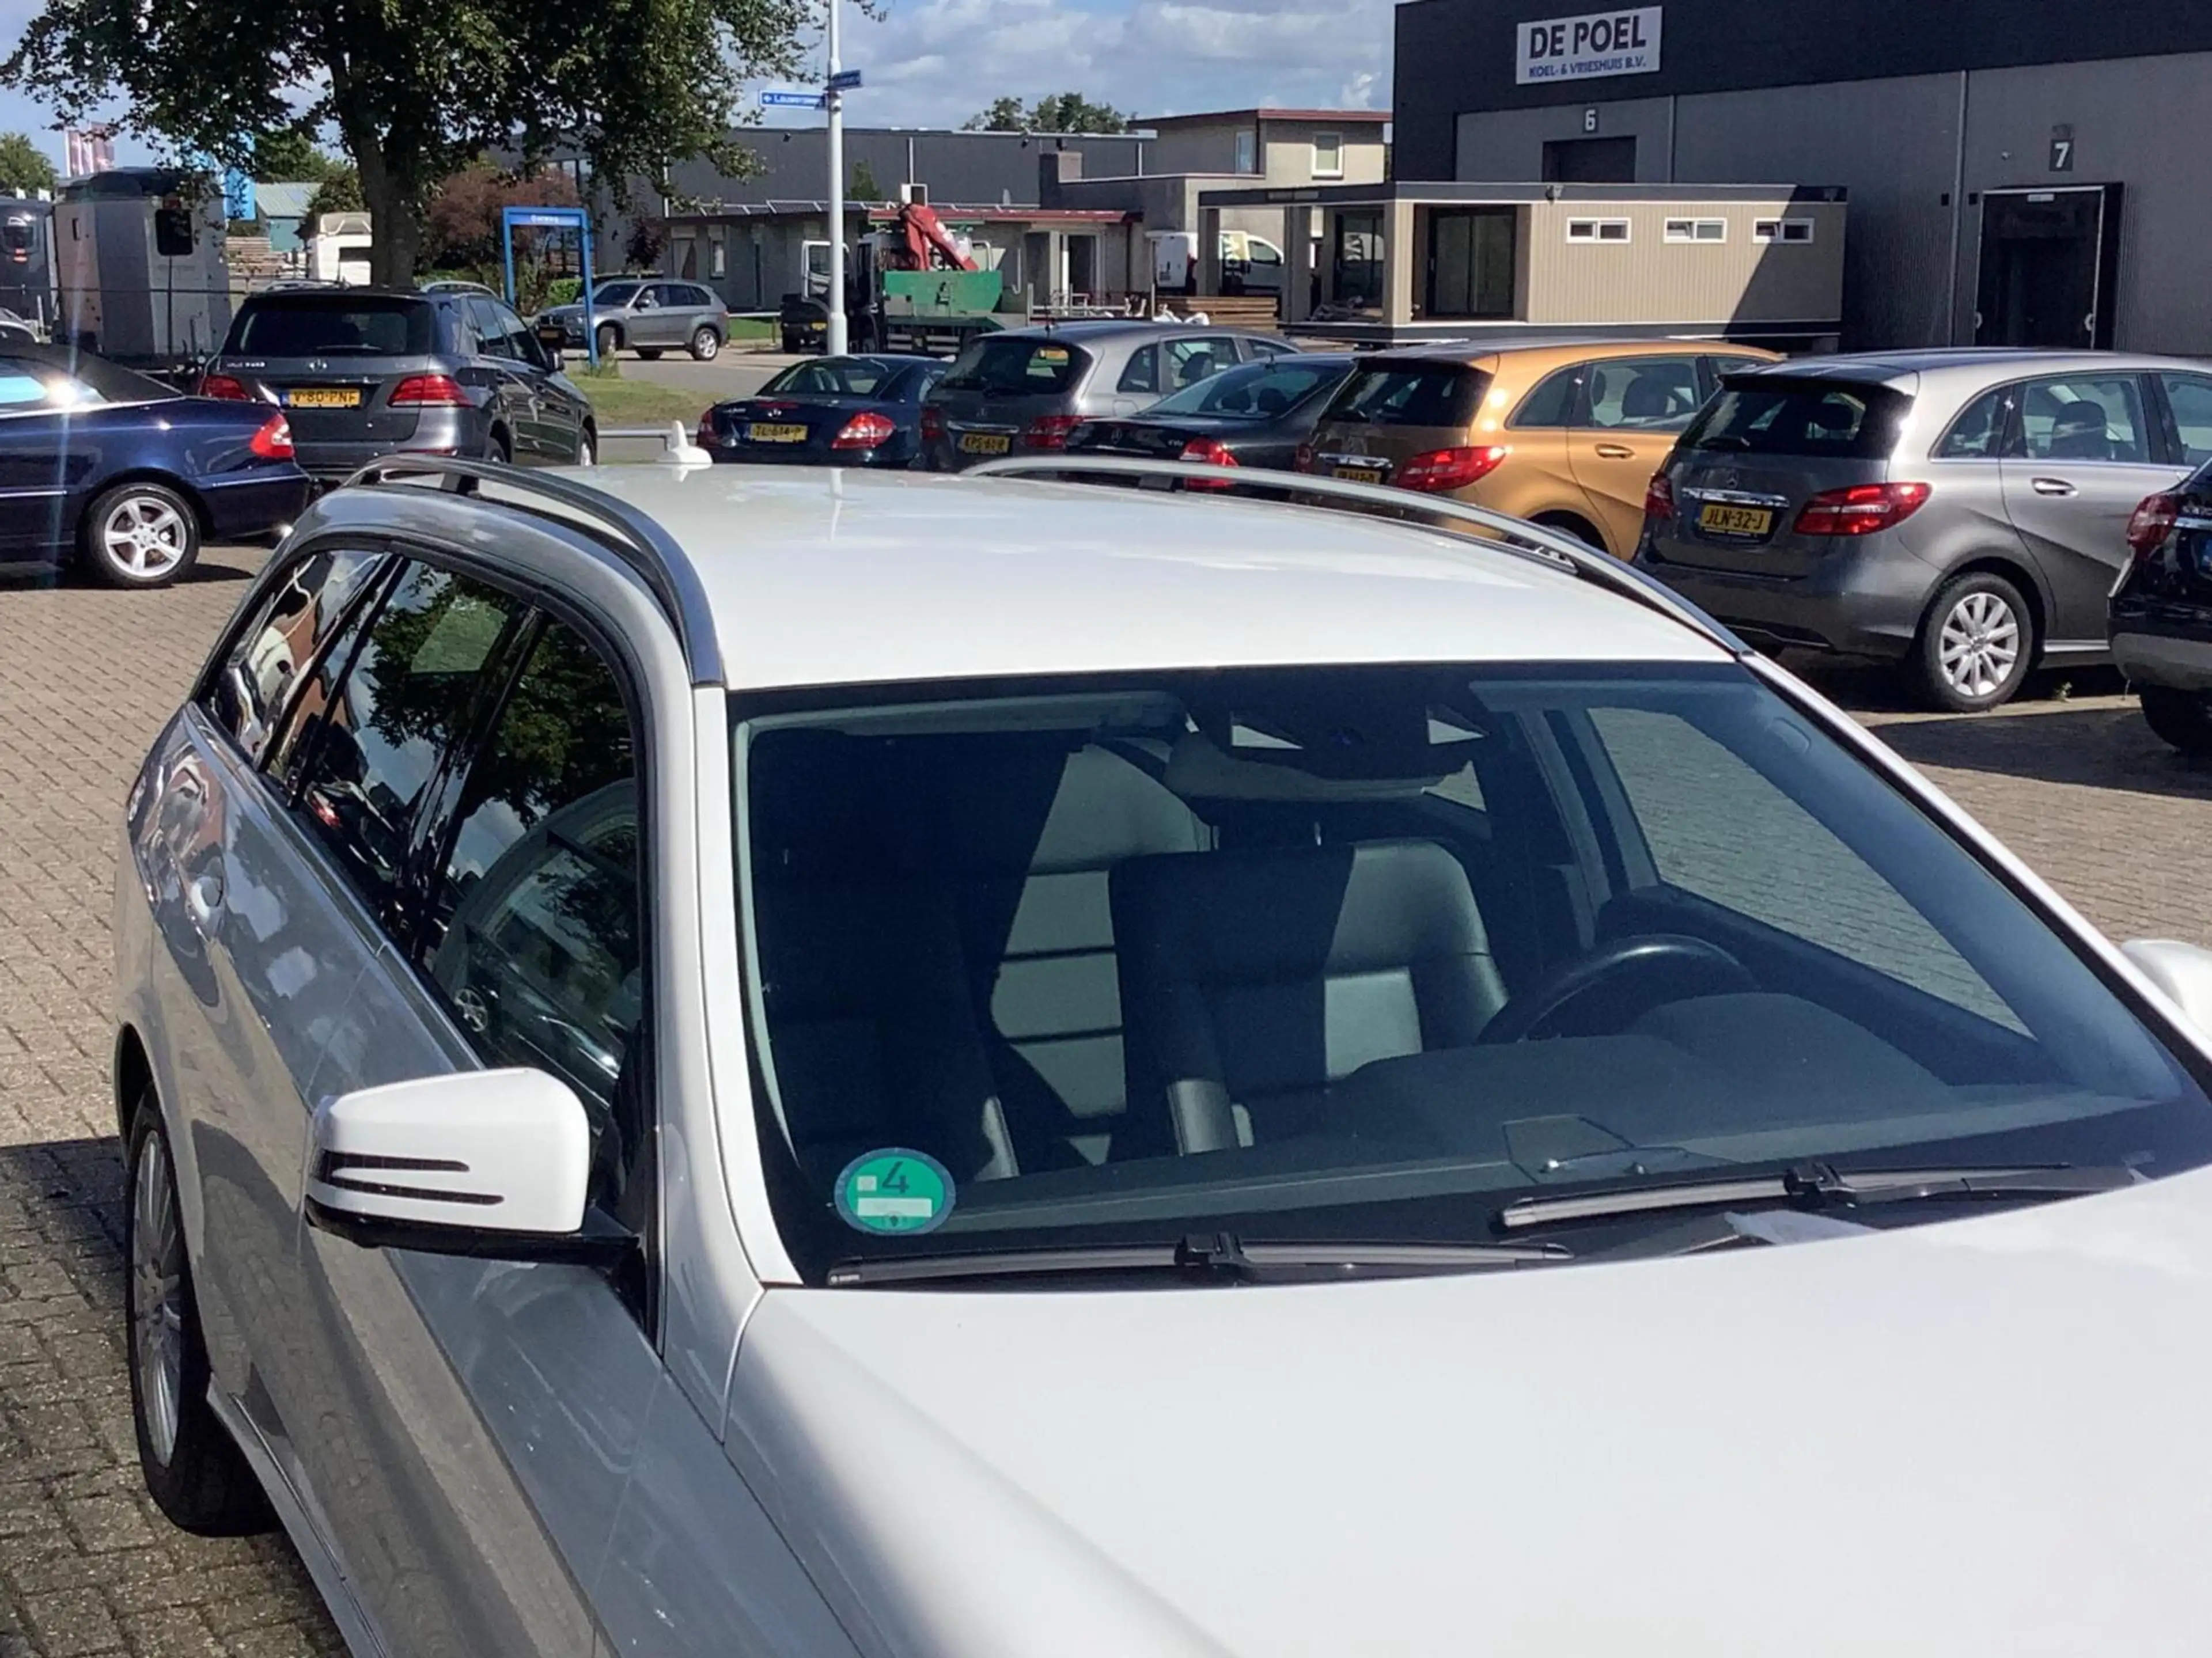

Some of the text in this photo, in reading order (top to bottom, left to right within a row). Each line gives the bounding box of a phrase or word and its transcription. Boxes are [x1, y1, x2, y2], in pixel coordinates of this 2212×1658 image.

[1529, 15, 1646, 59] DE POEL
[1529, 55, 1647, 78] KOEL- & VRIESHUIS B.V.
[1585, 109, 1596, 131] 6
[2055, 142, 2070, 168] 7
[1705, 508, 1764, 530] JLN-32-J
[882, 1160, 909, 1194] 4
